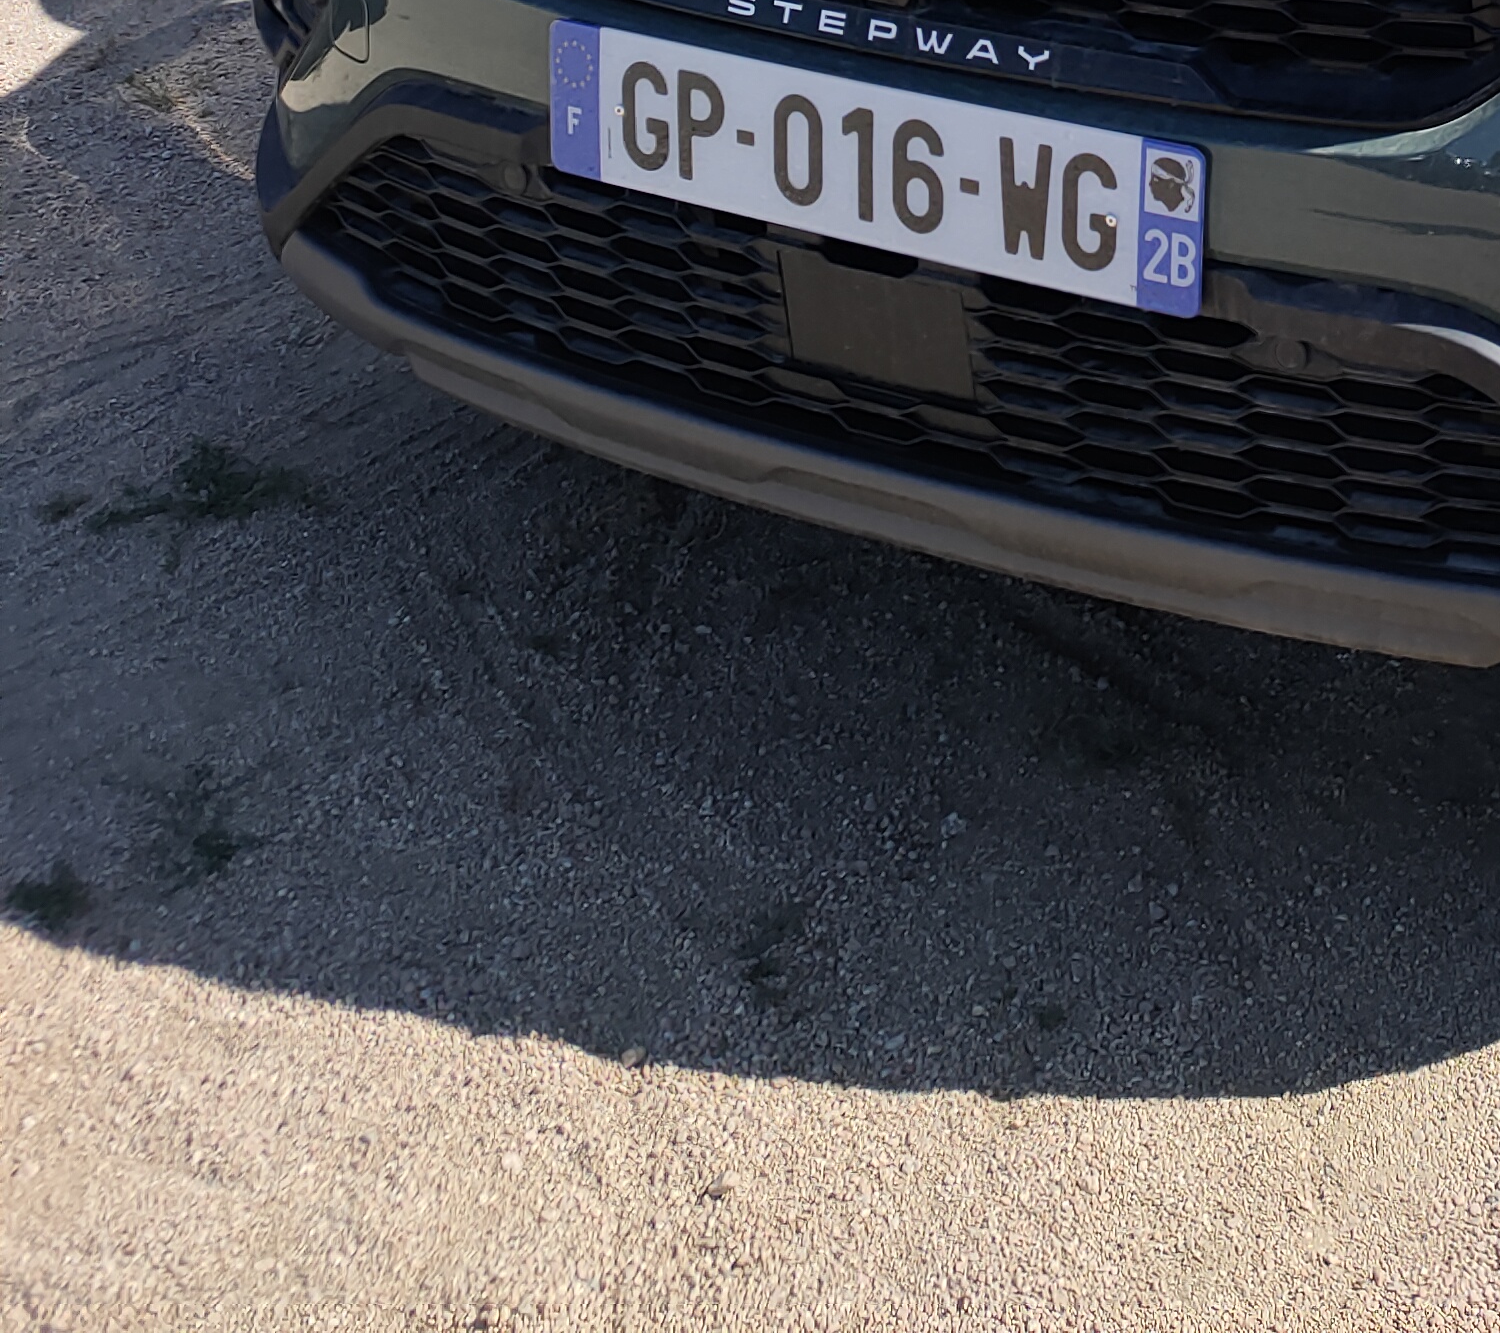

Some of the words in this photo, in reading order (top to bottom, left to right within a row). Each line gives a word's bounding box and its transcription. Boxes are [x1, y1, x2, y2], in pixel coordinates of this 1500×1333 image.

[567, 107, 581, 136] F
[622, 62, 1117, 271] GP-016-WG
[1143, 229, 1196, 288] 2B
